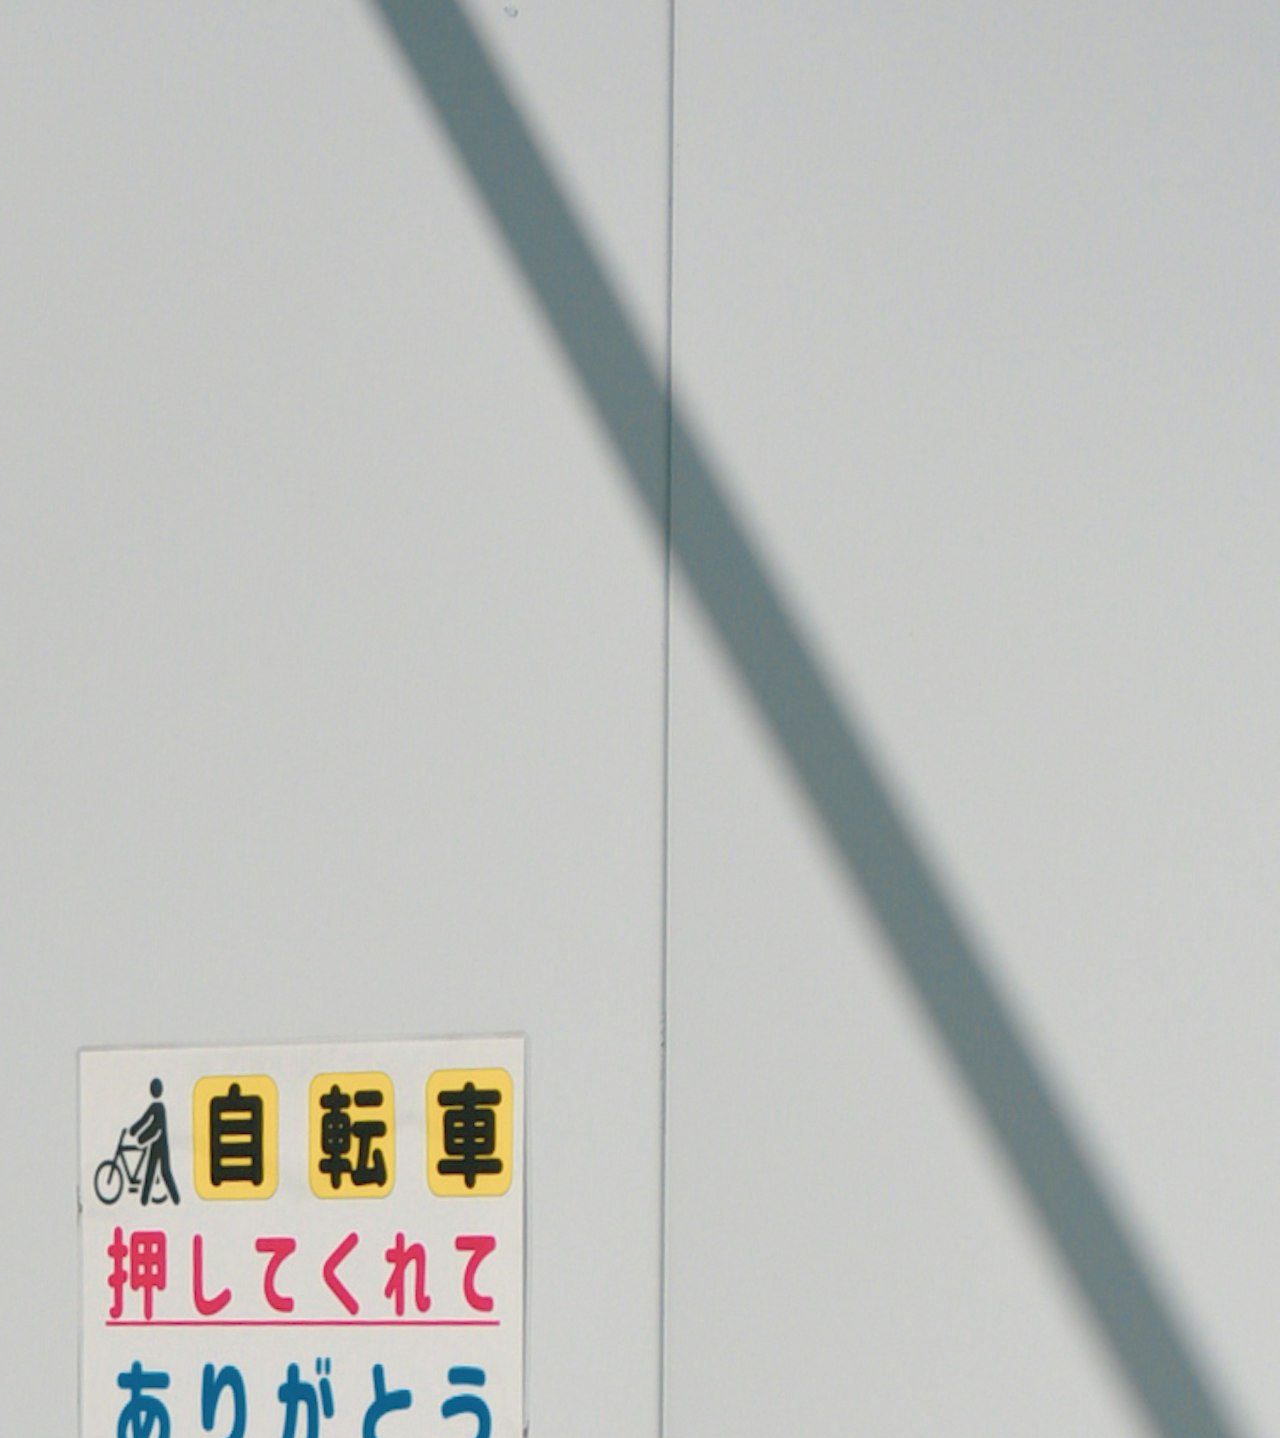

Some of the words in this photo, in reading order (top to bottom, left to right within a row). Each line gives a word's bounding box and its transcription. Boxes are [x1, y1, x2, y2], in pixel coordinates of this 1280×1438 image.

[209, 1081, 503, 1189] 自転車
[107, 1226, 496, 1319] 押してくれて
